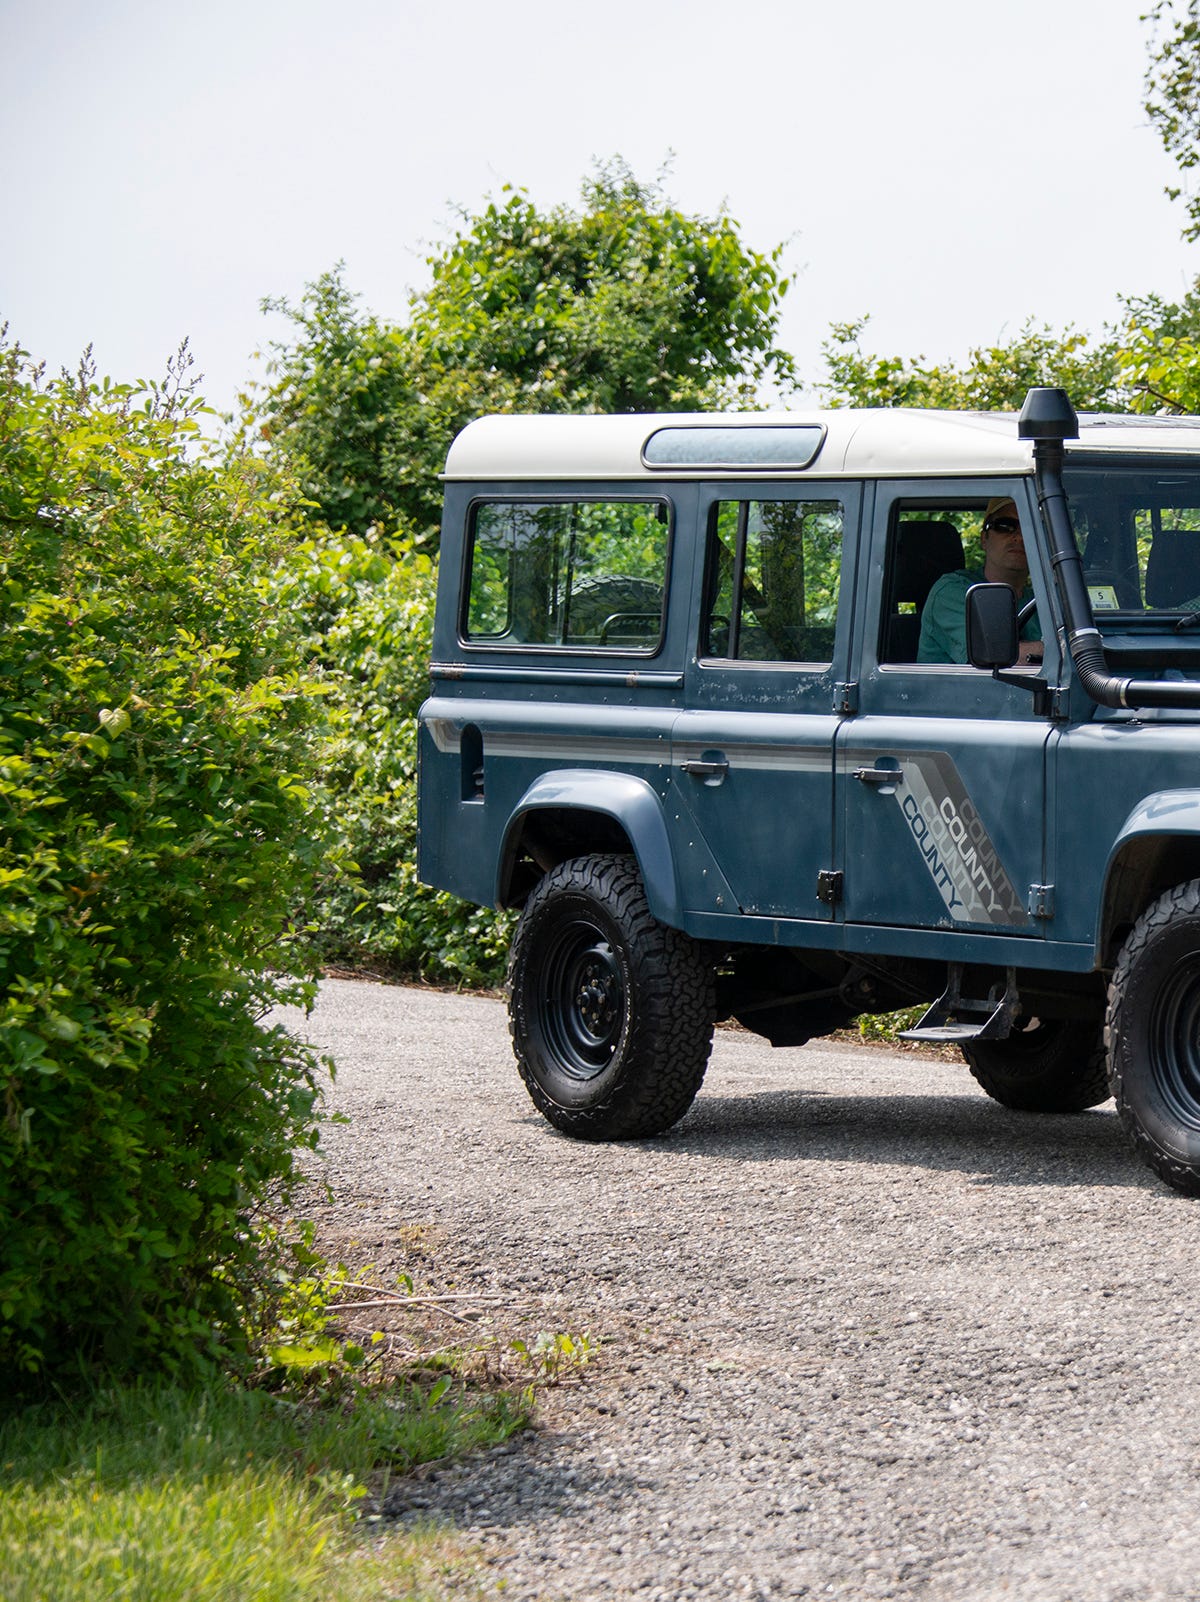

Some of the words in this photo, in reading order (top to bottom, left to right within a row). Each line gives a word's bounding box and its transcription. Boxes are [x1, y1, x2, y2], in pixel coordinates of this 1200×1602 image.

[902, 794, 963, 908] COUNTY
[921, 795, 984, 910] COUNTY
[940, 796, 1003, 913] COUNTY
[960, 798, 1023, 914] COUNTY
